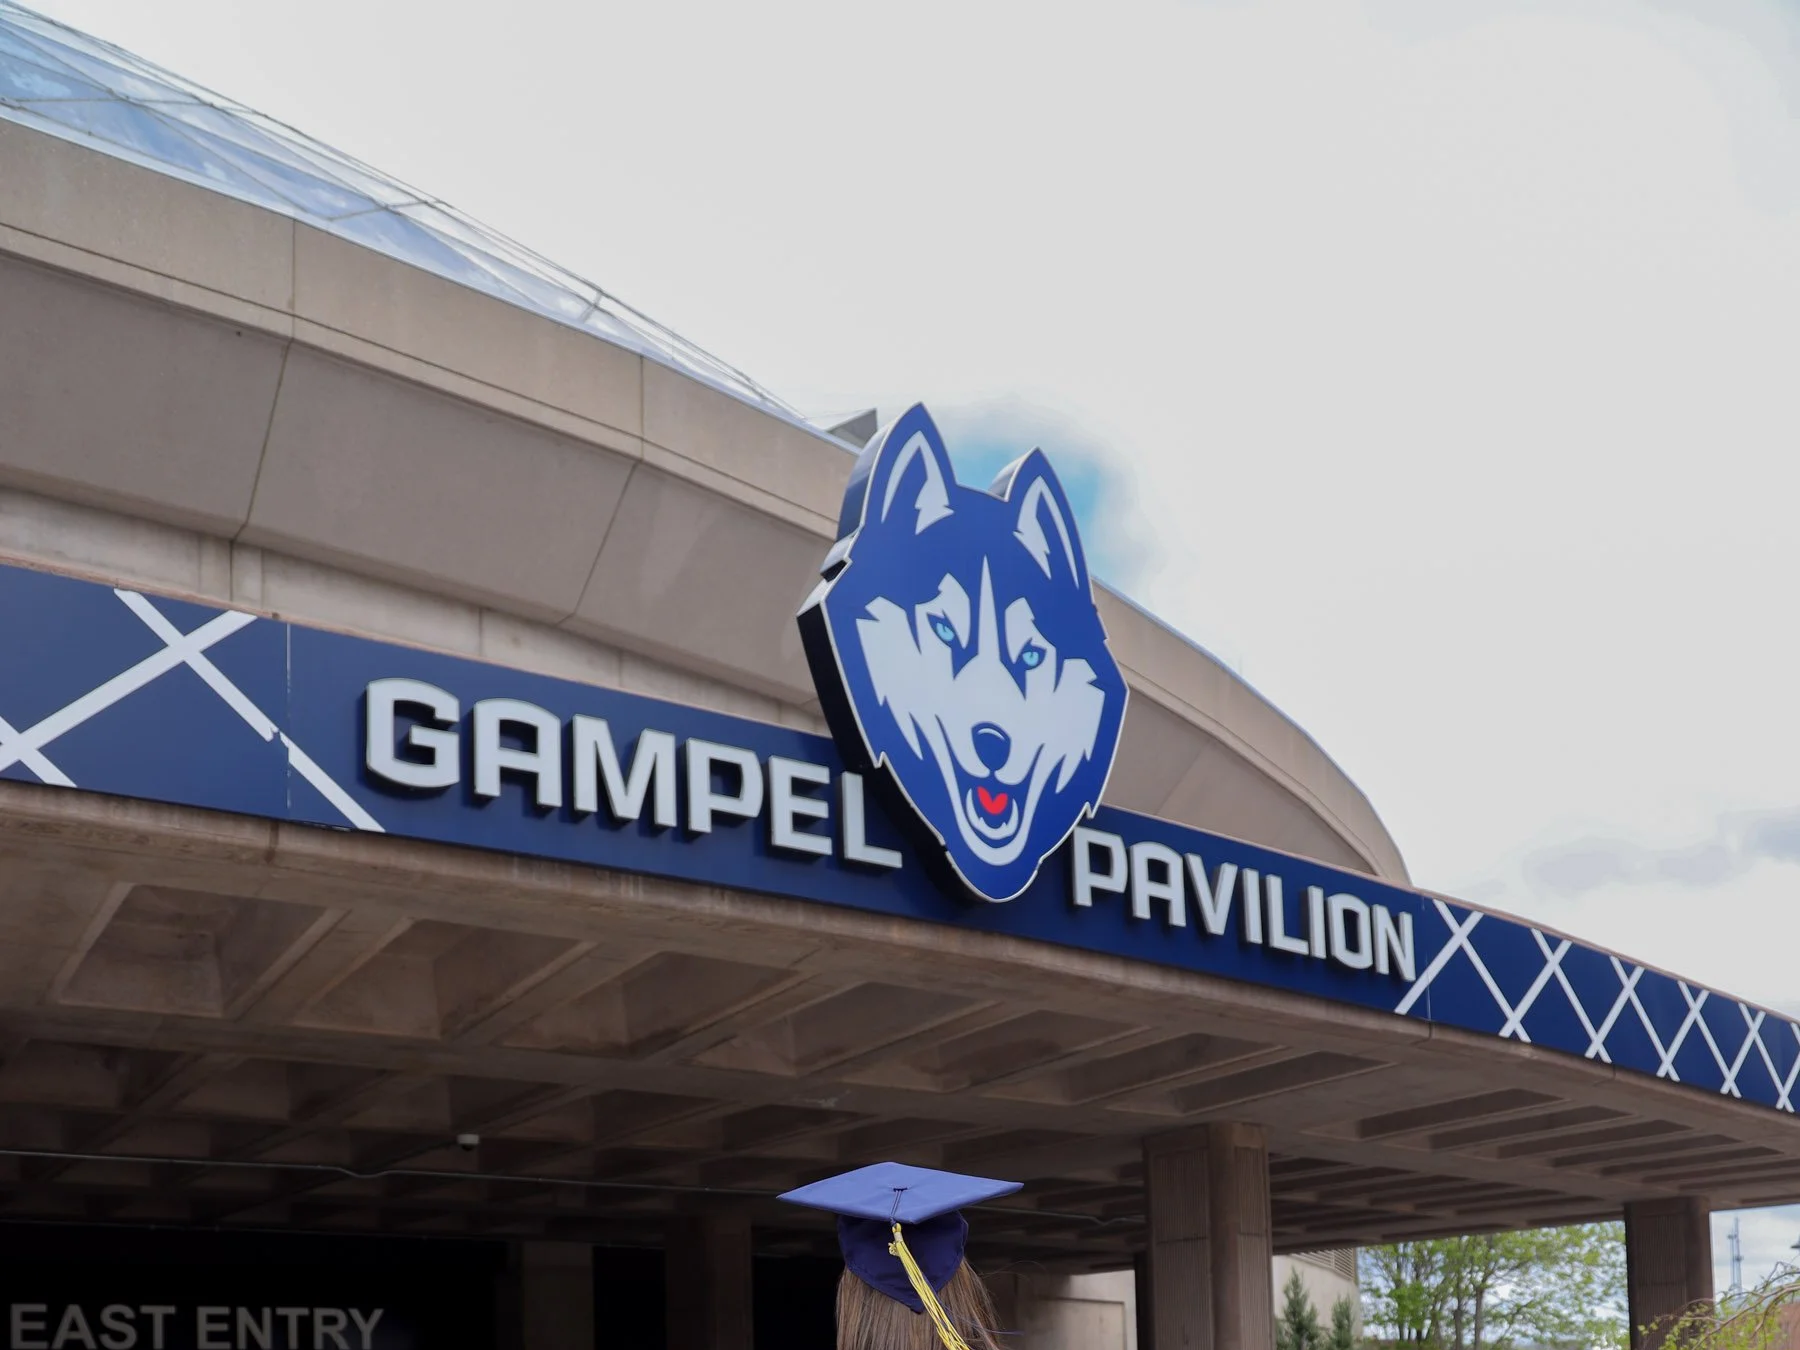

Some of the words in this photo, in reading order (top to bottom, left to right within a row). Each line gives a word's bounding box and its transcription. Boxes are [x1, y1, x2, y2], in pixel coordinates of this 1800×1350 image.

[365, 677, 903, 869] GAMPEL
[1072, 826, 1416, 982] PAVILION
[10, 1304, 176, 1350] EAST
[197, 1307, 384, 1350] ENTRY
